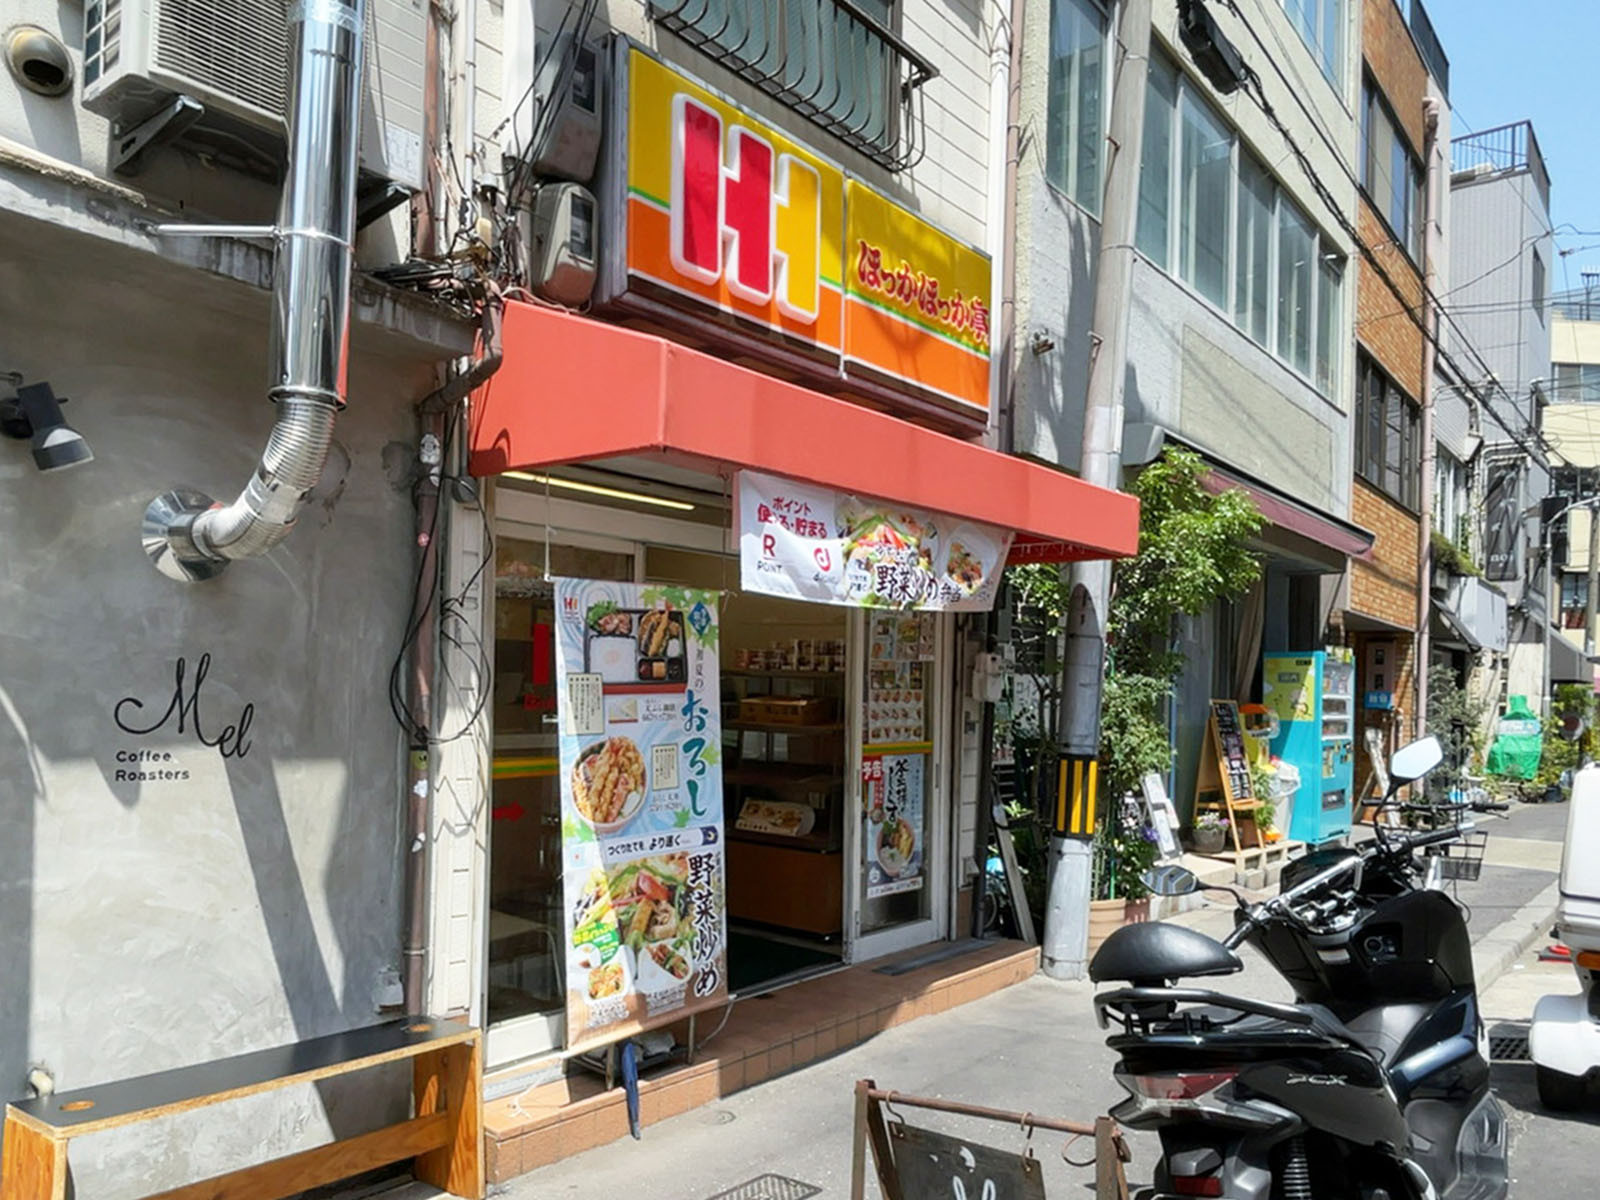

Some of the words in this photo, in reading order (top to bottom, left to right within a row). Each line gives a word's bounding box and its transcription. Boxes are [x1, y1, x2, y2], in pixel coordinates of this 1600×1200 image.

[857, 239, 990, 344] ほっかほっか亭
[772, 497, 812, 516] ポイント
[114, 652, 254, 758] Mel
[116, 751, 171, 762] Coffee
[681, 688, 709, 817] おろし
[115, 769, 190, 782] Roasters
[688, 852, 718, 997] 野菜炒め
